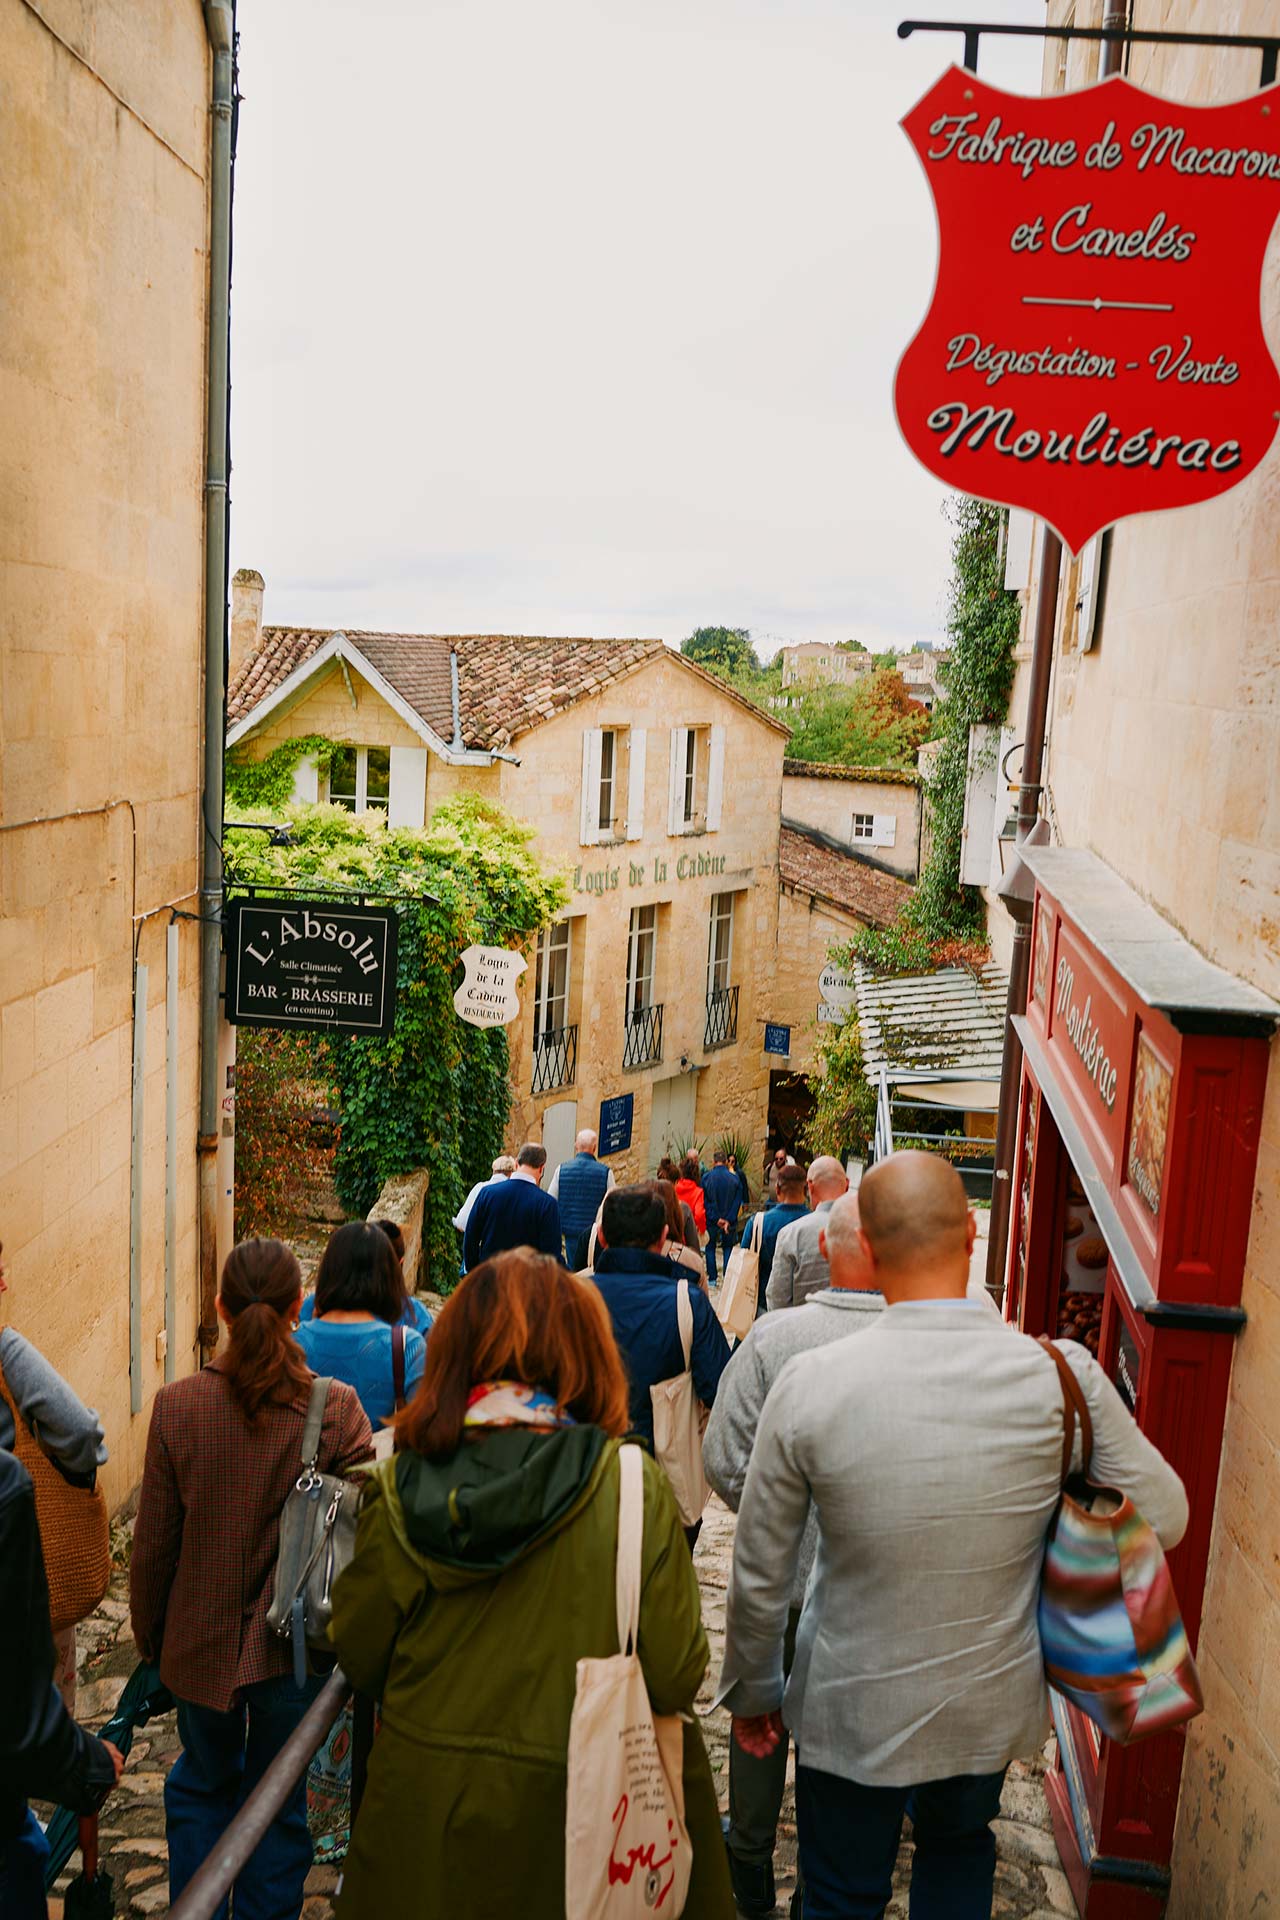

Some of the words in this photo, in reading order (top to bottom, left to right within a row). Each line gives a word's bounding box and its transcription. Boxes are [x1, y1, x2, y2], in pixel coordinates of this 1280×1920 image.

[928, 112, 1077, 178] Fabrique
[1084, 121, 1122, 169] de
[1130, 123, 1280, 180] Macaron
[1010, 215, 1046, 253] et
[1050, 203, 1196, 262] Canelés
[946, 334, 1117, 386] Dégustation
[1148, 337, 1240, 386] Vente
[926, 401, 1242, 473] Mouliérac
[573, 864, 620, 897] Logis
[629, 861, 645, 887] de
[654, 858, 667, 883] la
[676, 850, 727, 880] Cadène
[279, 959, 299, 971] Salle
[300, 961, 343, 974] Climatisée
[479, 953, 510, 970] Logis
[476, 971, 489, 984] de
[247, 984, 278, 999] BAR
[291, 987, 374, 1007] BRASSERIE
[467, 987, 508, 1004] Cadène
[284, 1003, 299, 1015] (en
[299, 1004, 335, 1017] continu)
[463, 1006, 505, 1021] RESTAURANT
[1057, 956, 1117, 1108] Mouliérac
